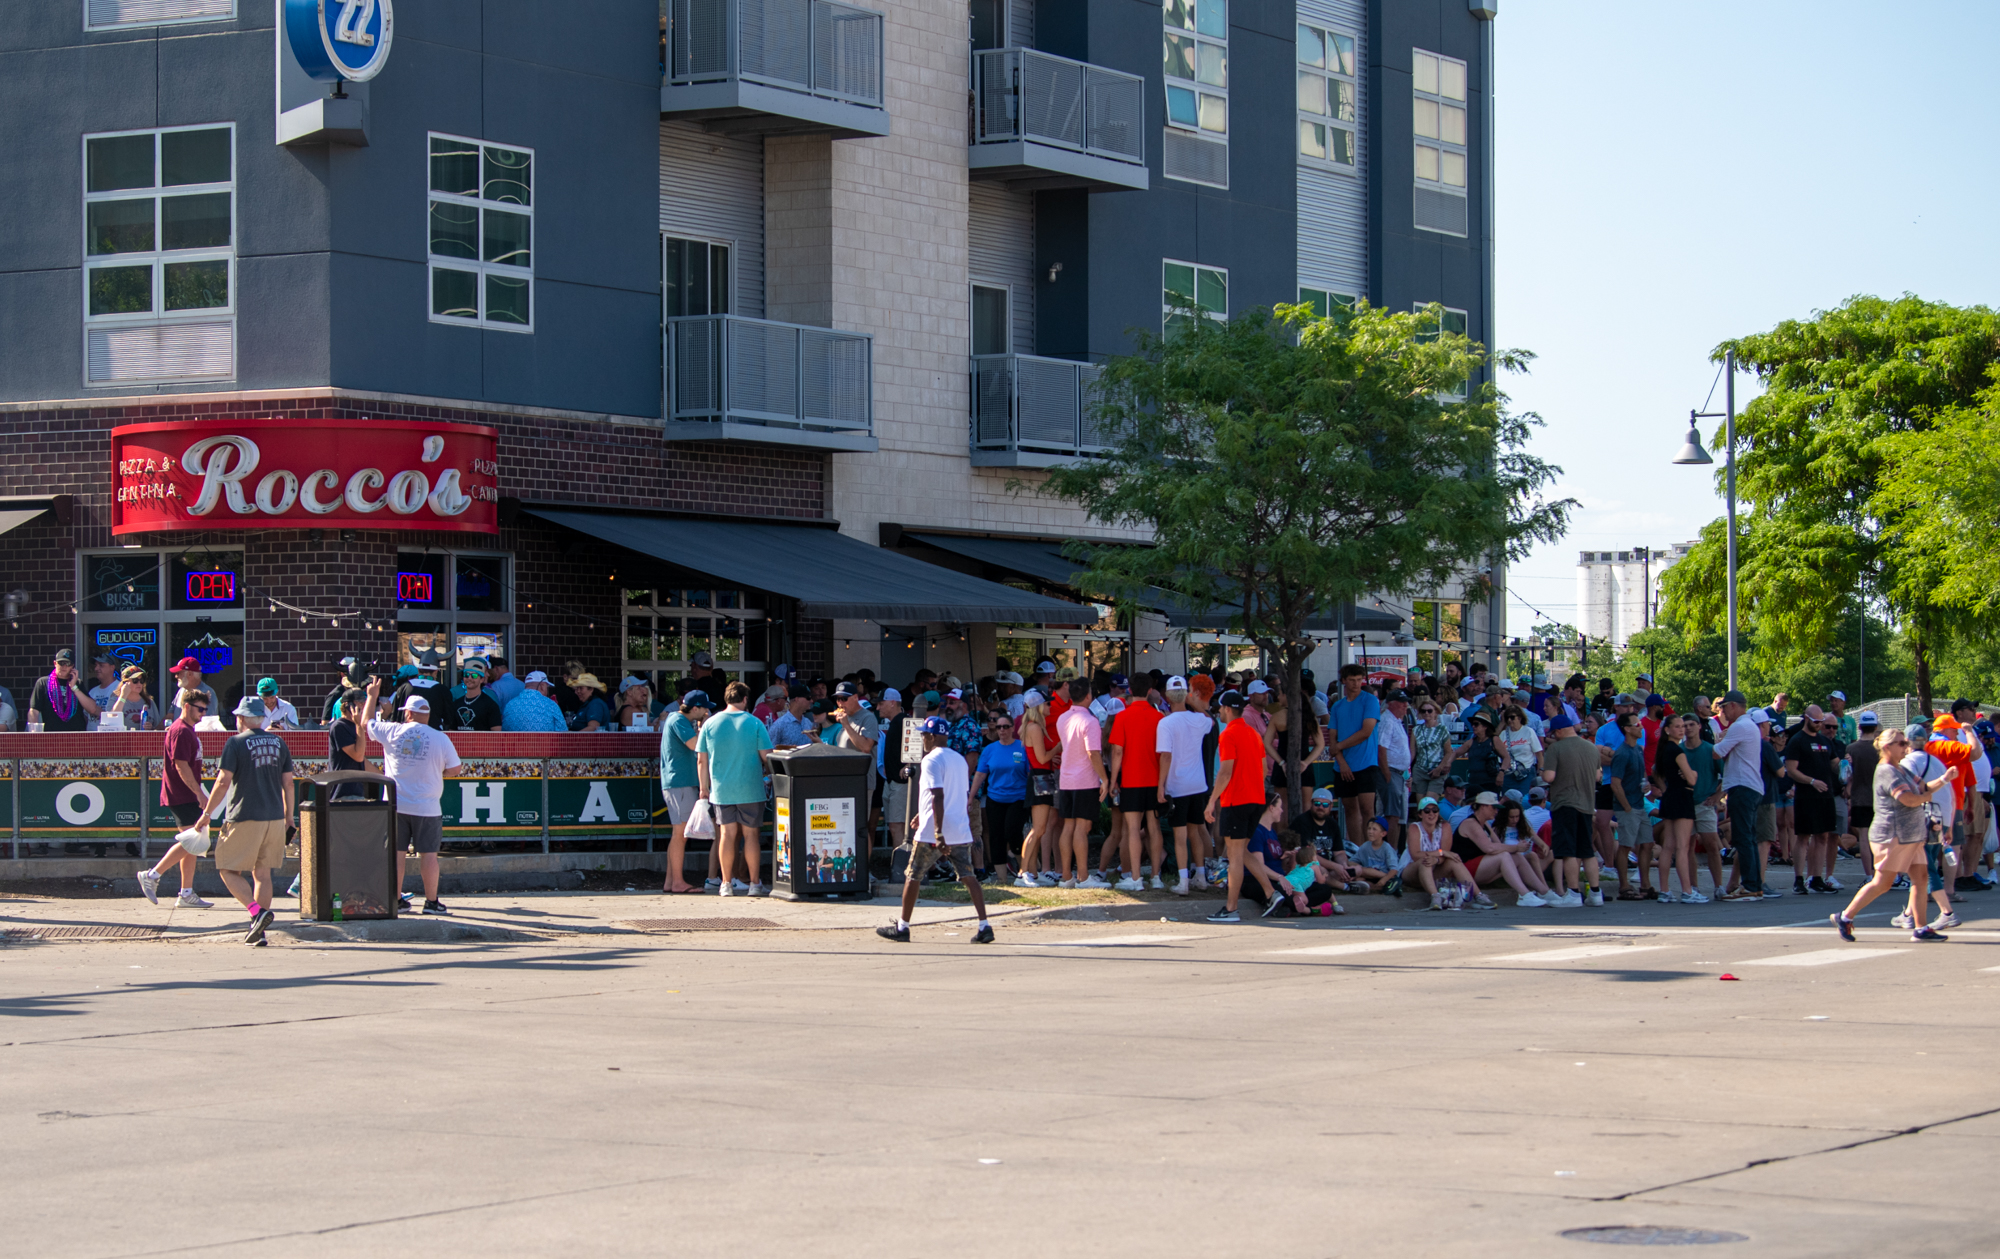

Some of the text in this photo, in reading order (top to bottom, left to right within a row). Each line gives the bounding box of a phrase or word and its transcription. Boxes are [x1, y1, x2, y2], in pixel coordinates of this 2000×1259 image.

[334, 0, 375, 47] 22
[119, 456, 170, 476] PIZZA &
[181, 434, 472, 516] Rocco's
[188, 574, 233, 599] OPEN
[399, 574, 431, 600] OPEN
[106, 593, 145, 607] BUSCH
[99, 631, 153, 643] BUD LIGHT
[1358, 657, 1404, 666] PRIVATE
[938, 723, 946, 734] B
[246, 737, 281, 750] CHAMPIONS
[55, 781, 620, 826] O H A
[814, 803, 829, 811] FBG
